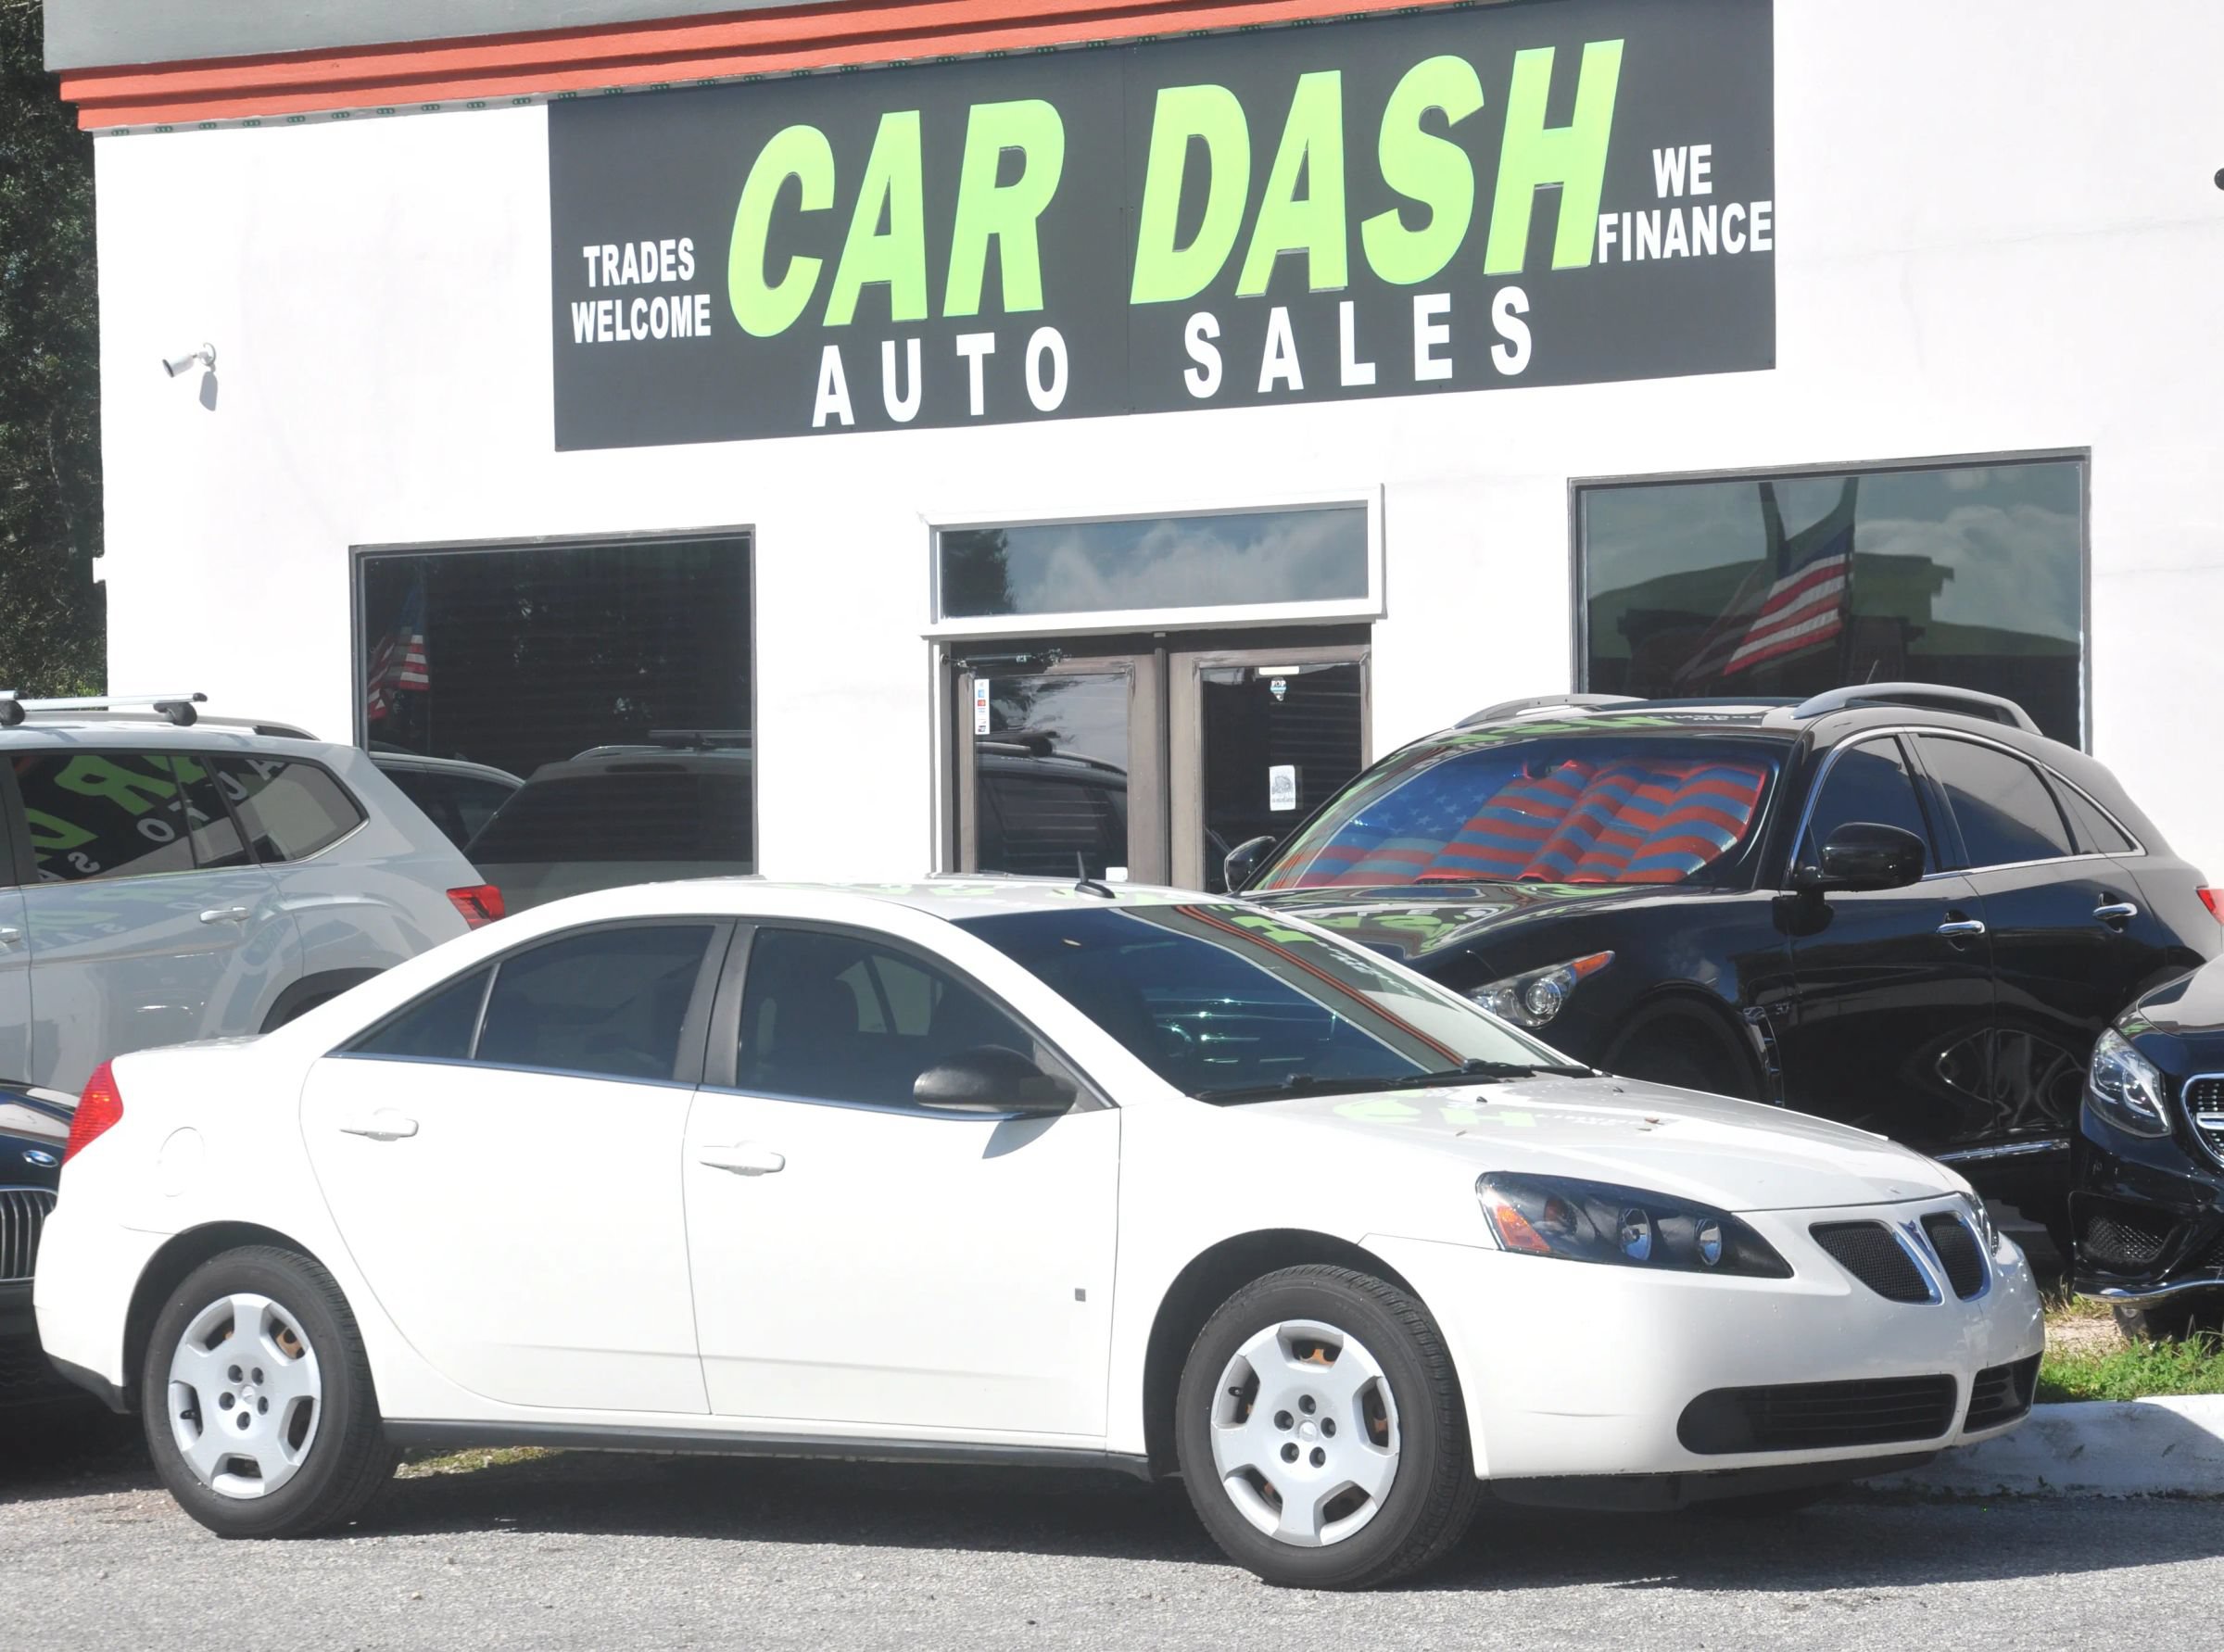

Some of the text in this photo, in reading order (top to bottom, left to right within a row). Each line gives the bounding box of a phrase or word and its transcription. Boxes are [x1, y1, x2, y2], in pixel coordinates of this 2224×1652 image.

[728, 39, 1624, 337] CAR DASH
[1652, 144, 1712, 198] WE
[1598, 200, 1773, 264] FINANCE
[583, 237, 696, 288] TRADES
[571, 294, 712, 344] WELCOME
[812, 285, 1533, 428] AUTO SALES
